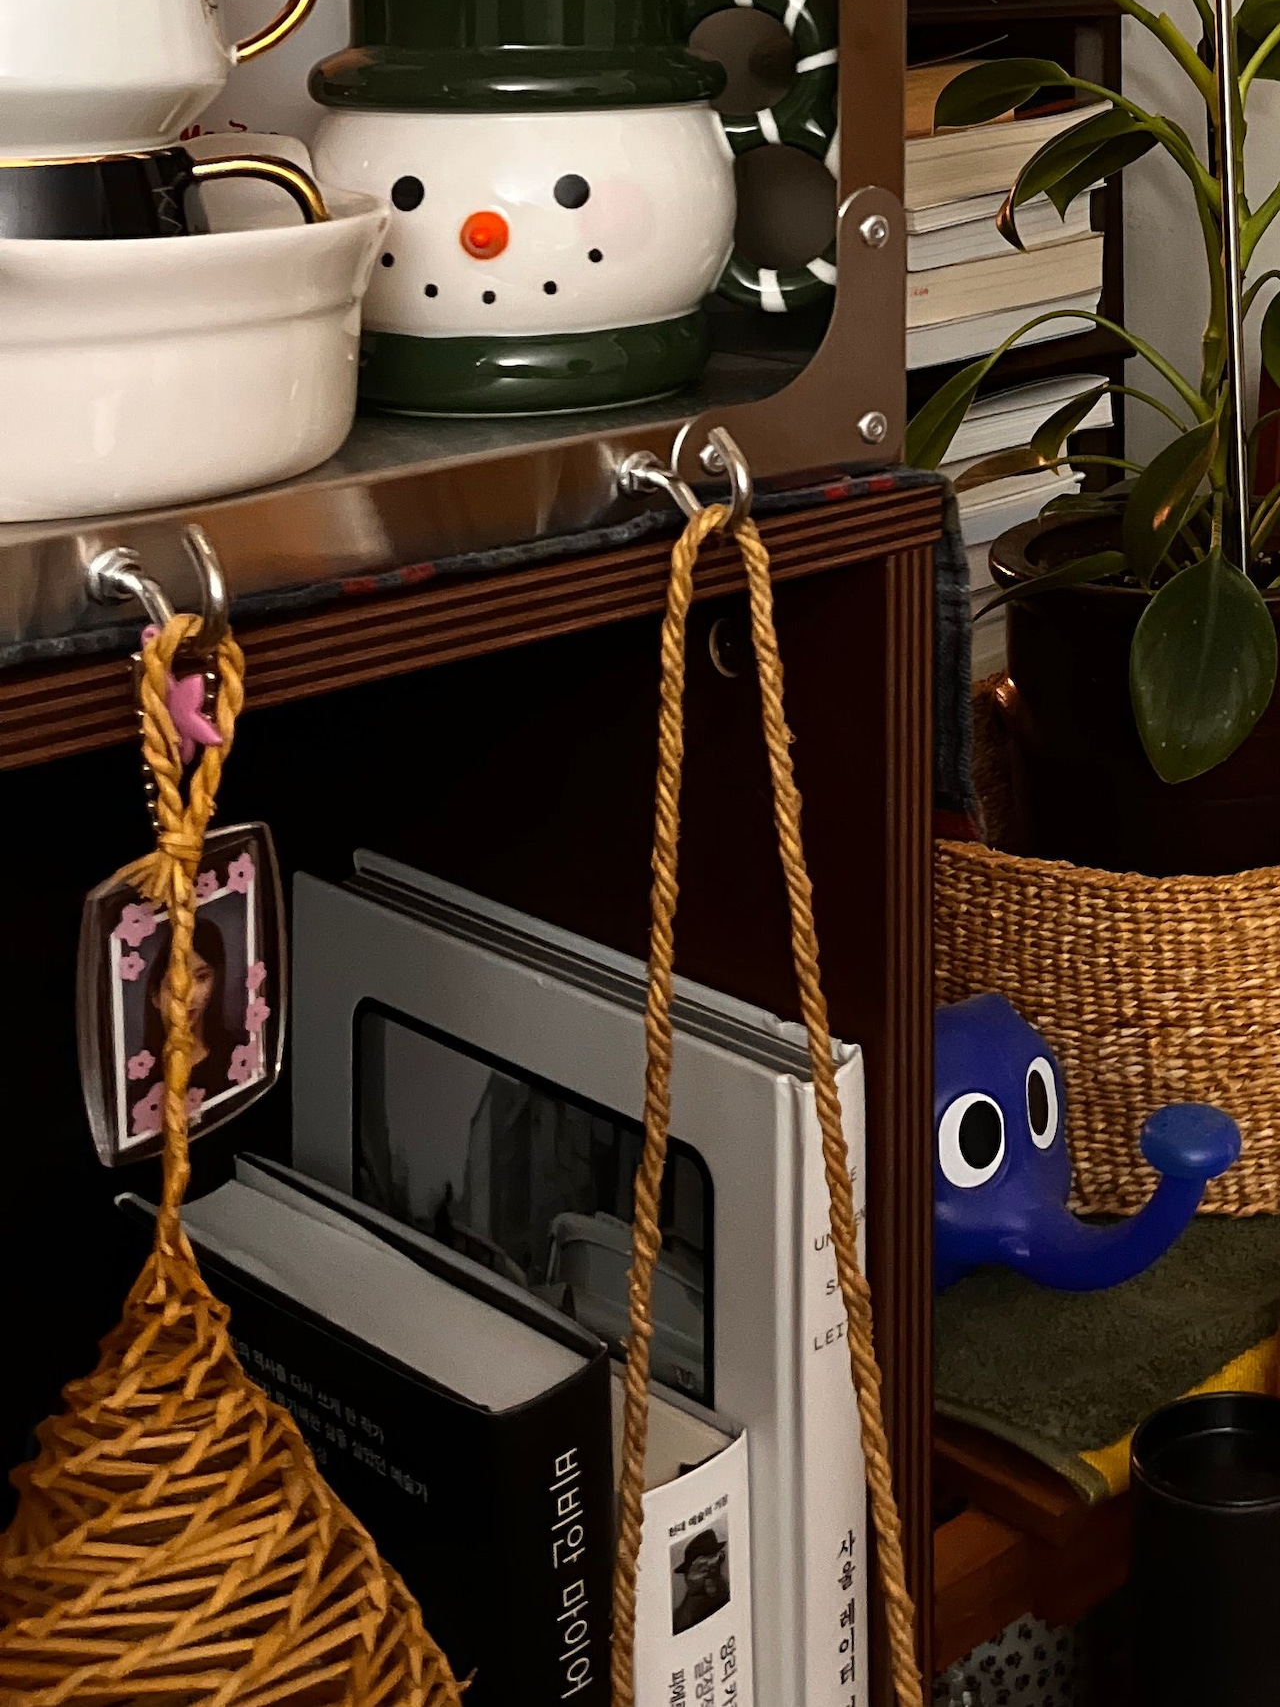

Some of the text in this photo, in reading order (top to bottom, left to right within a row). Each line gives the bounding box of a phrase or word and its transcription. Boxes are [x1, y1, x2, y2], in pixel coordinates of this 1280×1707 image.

[549, 1447, 594, 1700] 비비안 마이어
[721, 1635, 738, 1683] 앙리
